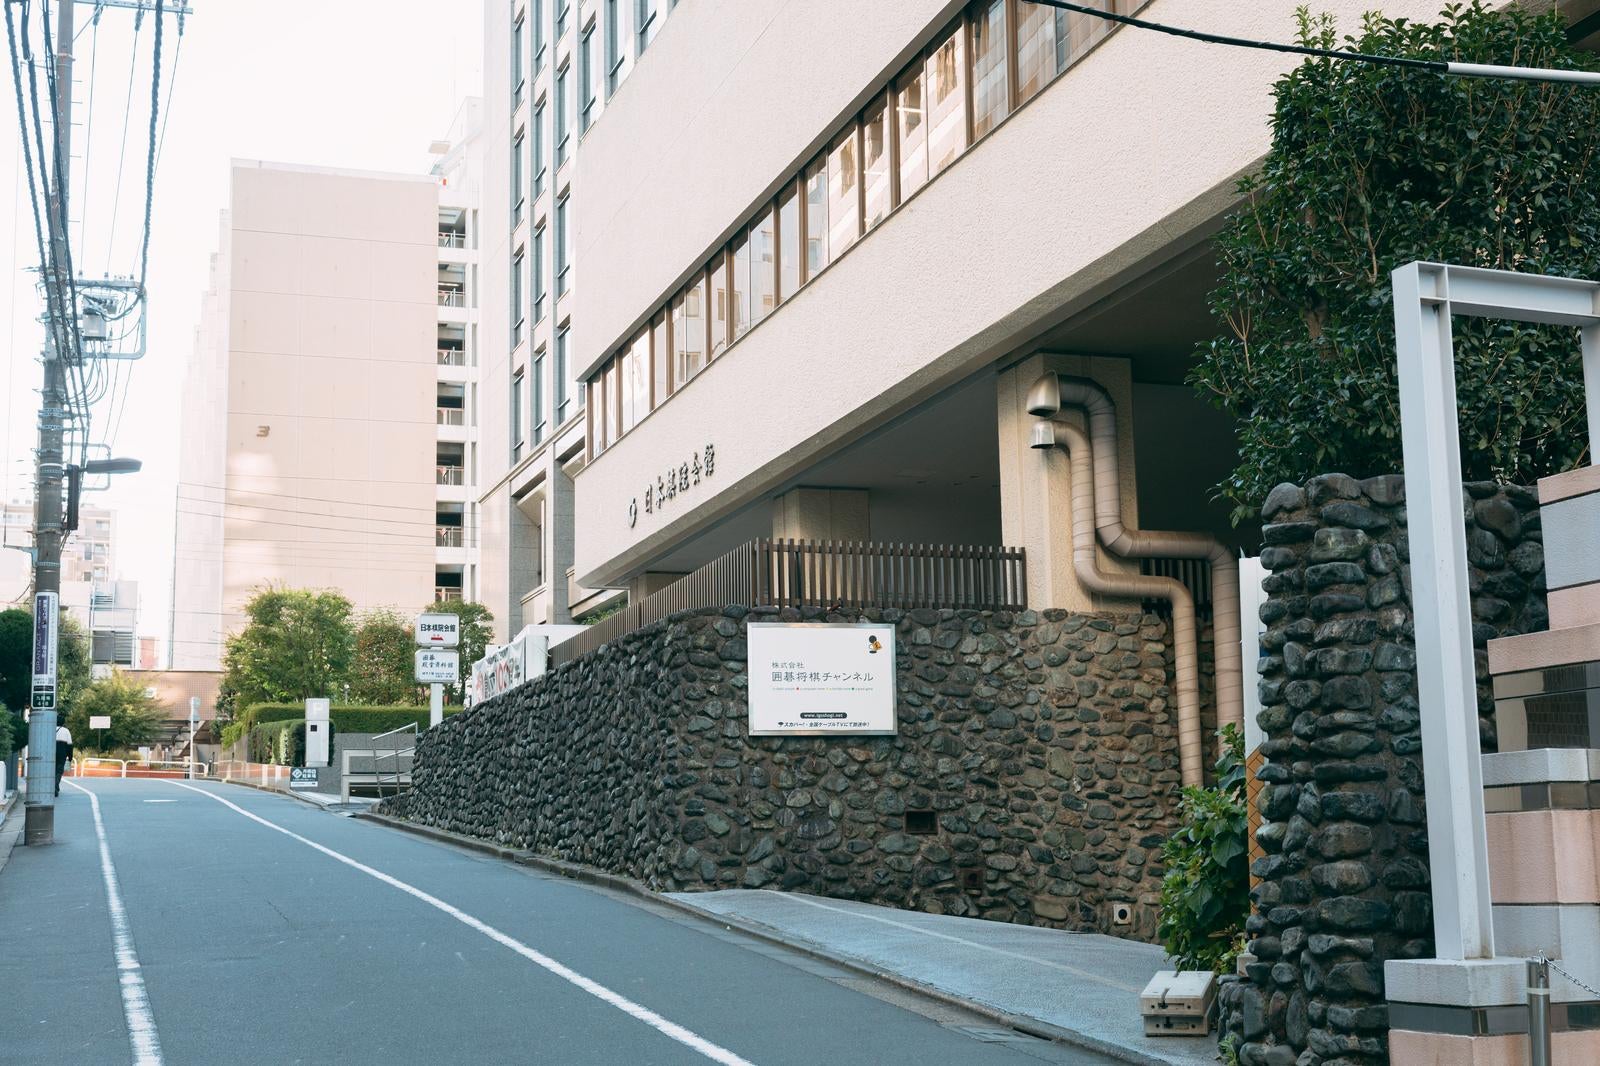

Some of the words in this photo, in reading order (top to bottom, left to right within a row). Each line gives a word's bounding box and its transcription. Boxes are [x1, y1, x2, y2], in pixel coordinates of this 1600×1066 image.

[420, 623, 456, 632] 日本棋院会館
[772, 661, 805, 669] 株式会社
[772, 671, 874, 682] 囲碁将棋チャンネル
